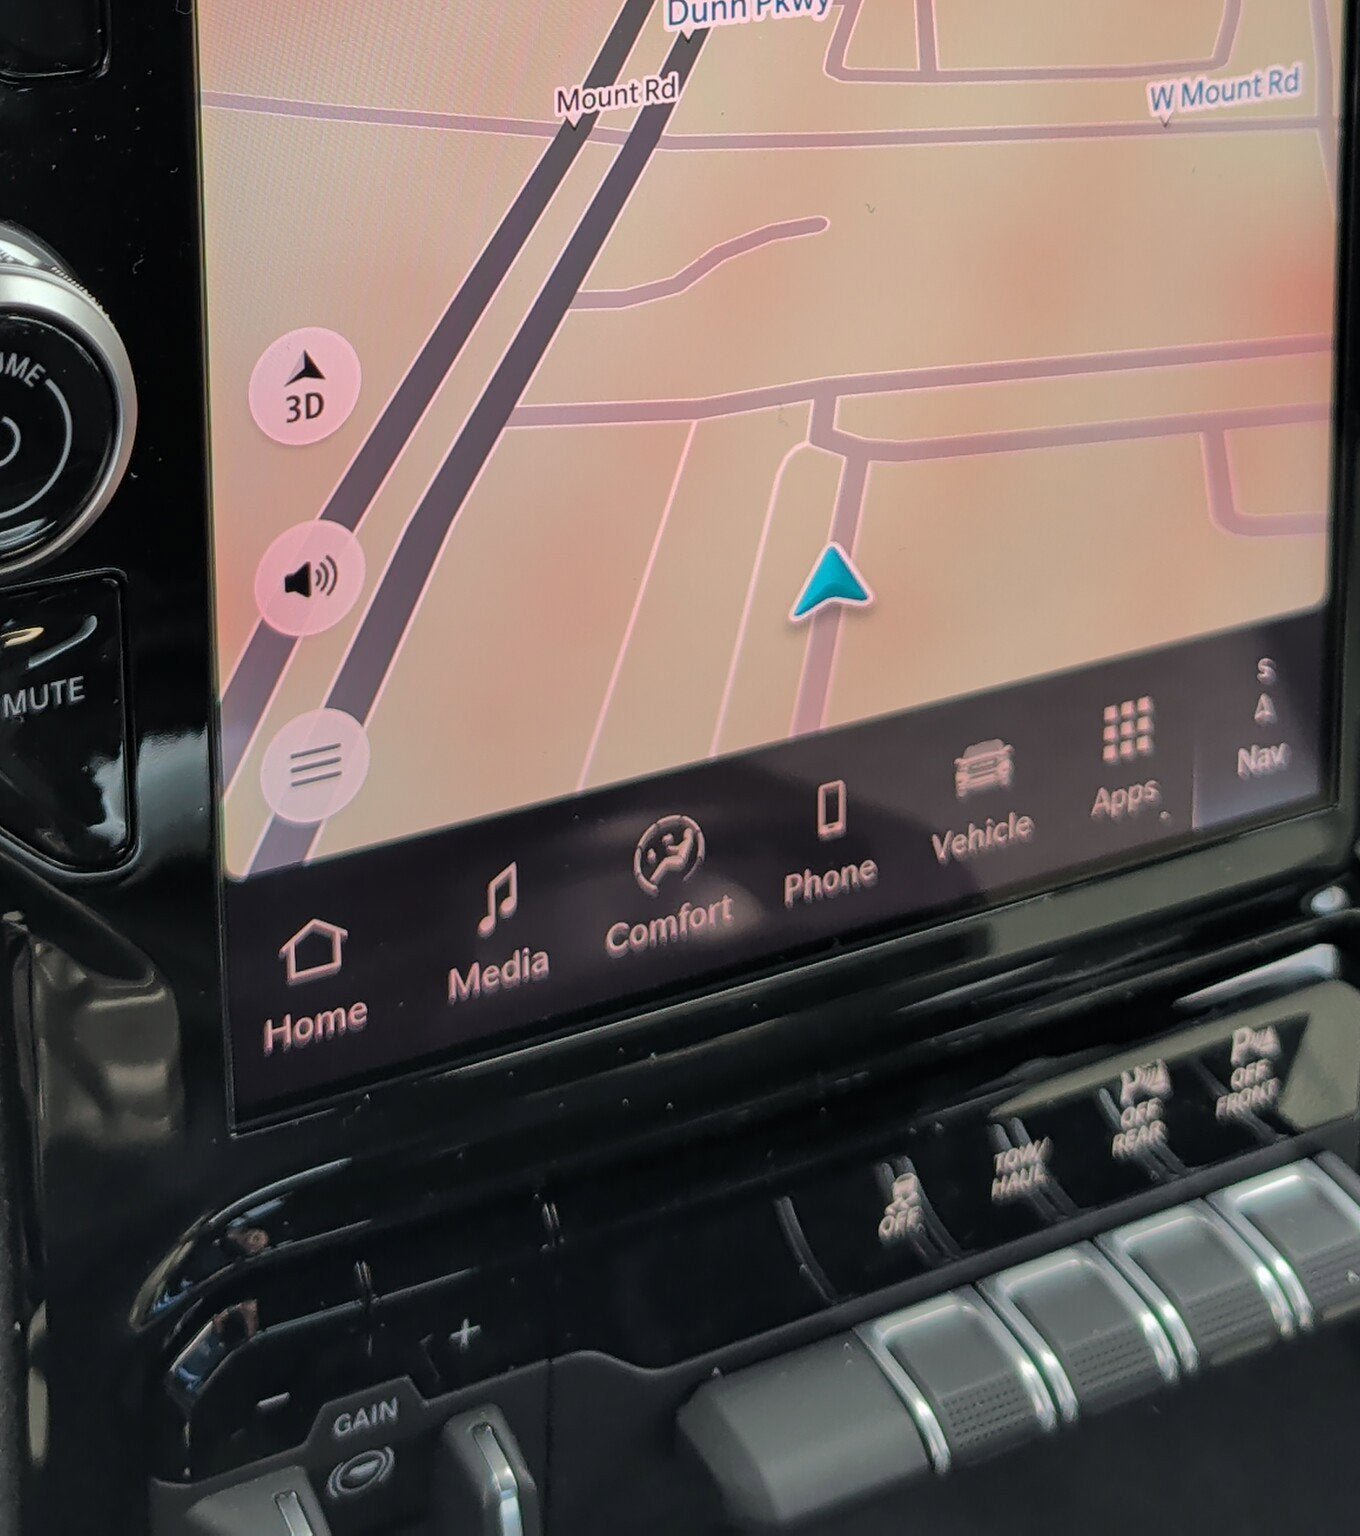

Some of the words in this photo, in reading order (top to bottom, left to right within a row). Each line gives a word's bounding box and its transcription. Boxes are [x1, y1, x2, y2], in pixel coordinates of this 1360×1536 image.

[557, 81, 638, 114] Mount
[644, 75, 678, 104] Rd
[1150, 86, 1177, 113] W
[1181, 77, 1262, 109] Mount
[1267, 68, 1301, 97] Rd
[285, 391, 326, 424] 3D
[2, 675, 87, 720] MUTE
[1237, 741, 1292, 779] Nav
[1091, 778, 1161, 822] Apps
[931, 812, 1035, 864] Vehicle
[782, 855, 878, 908] Phone
[604, 892, 735, 955] Comfort
[446, 949, 551, 1005] Media
[262, 995, 369, 1054] Home
[332, 1396, 400, 1438] GAIN
